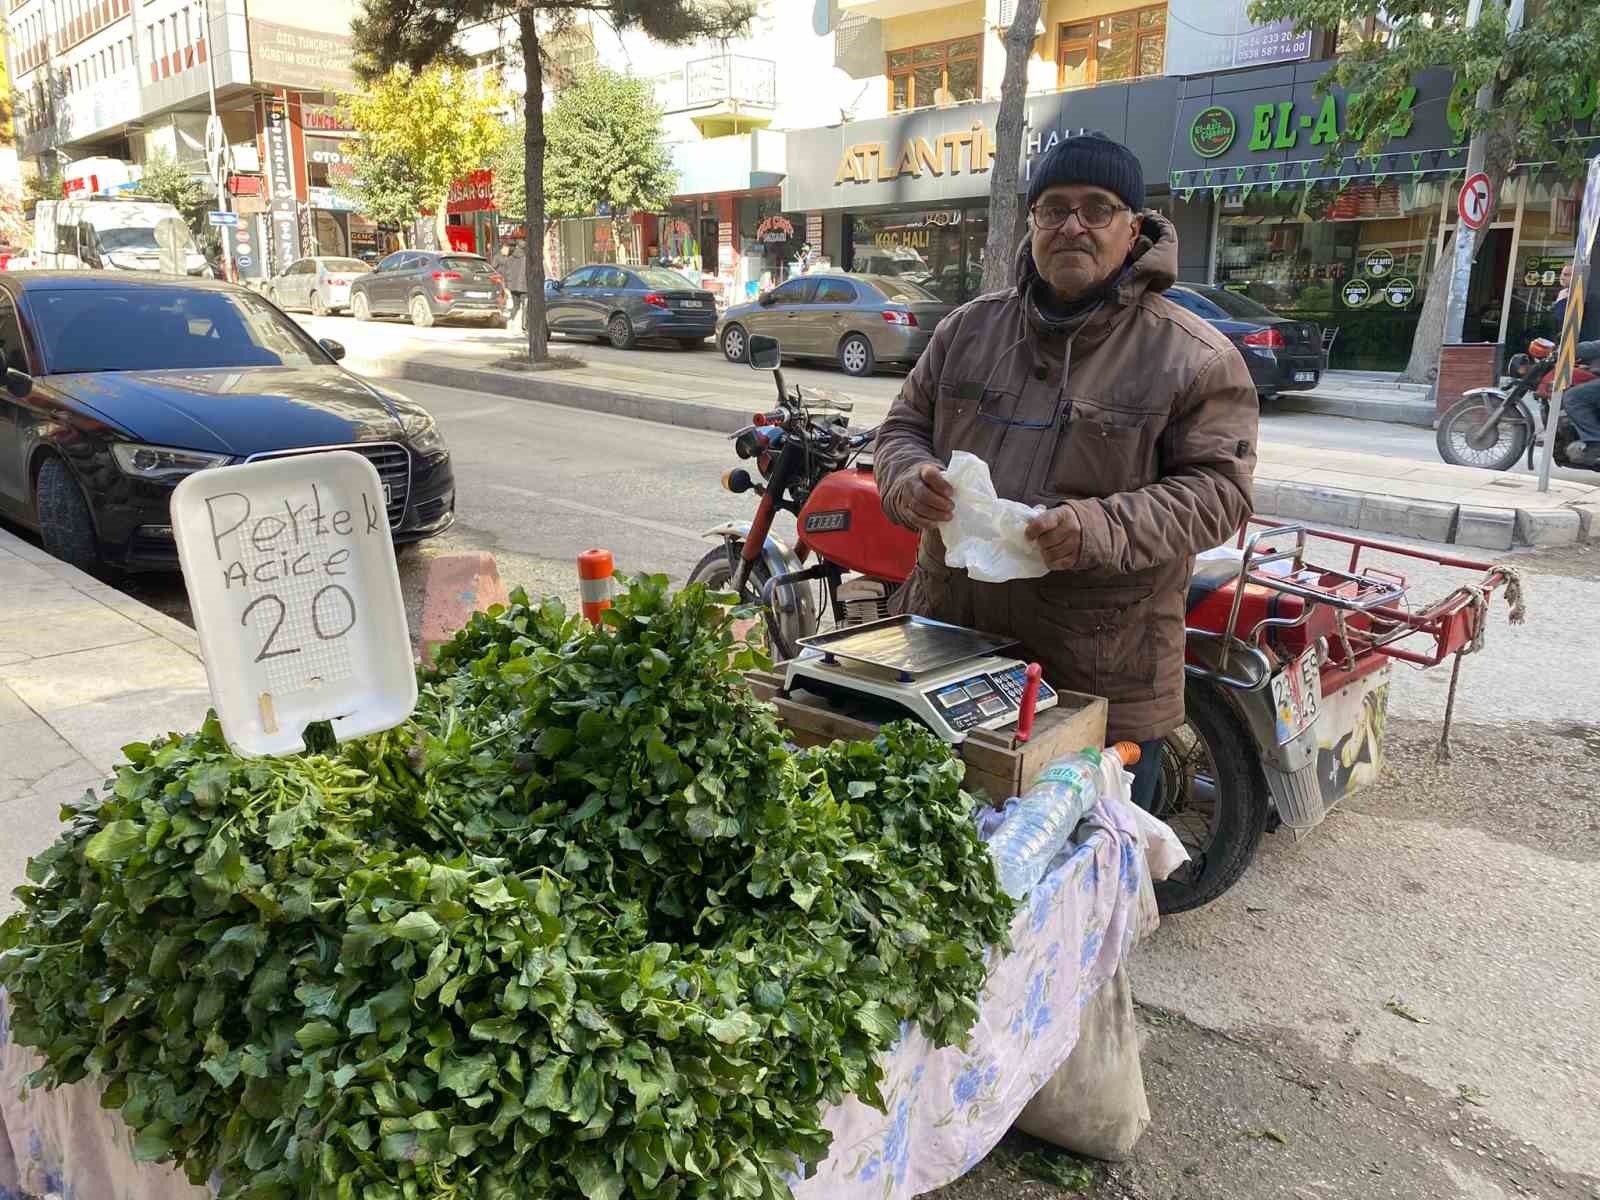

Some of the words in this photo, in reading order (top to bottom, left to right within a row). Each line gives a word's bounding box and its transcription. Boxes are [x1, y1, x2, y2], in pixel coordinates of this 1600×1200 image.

[1281, 31, 1293, 42] 20
[1293, 42, 1305, 52] 00
[241, 584, 356, 663] 20
